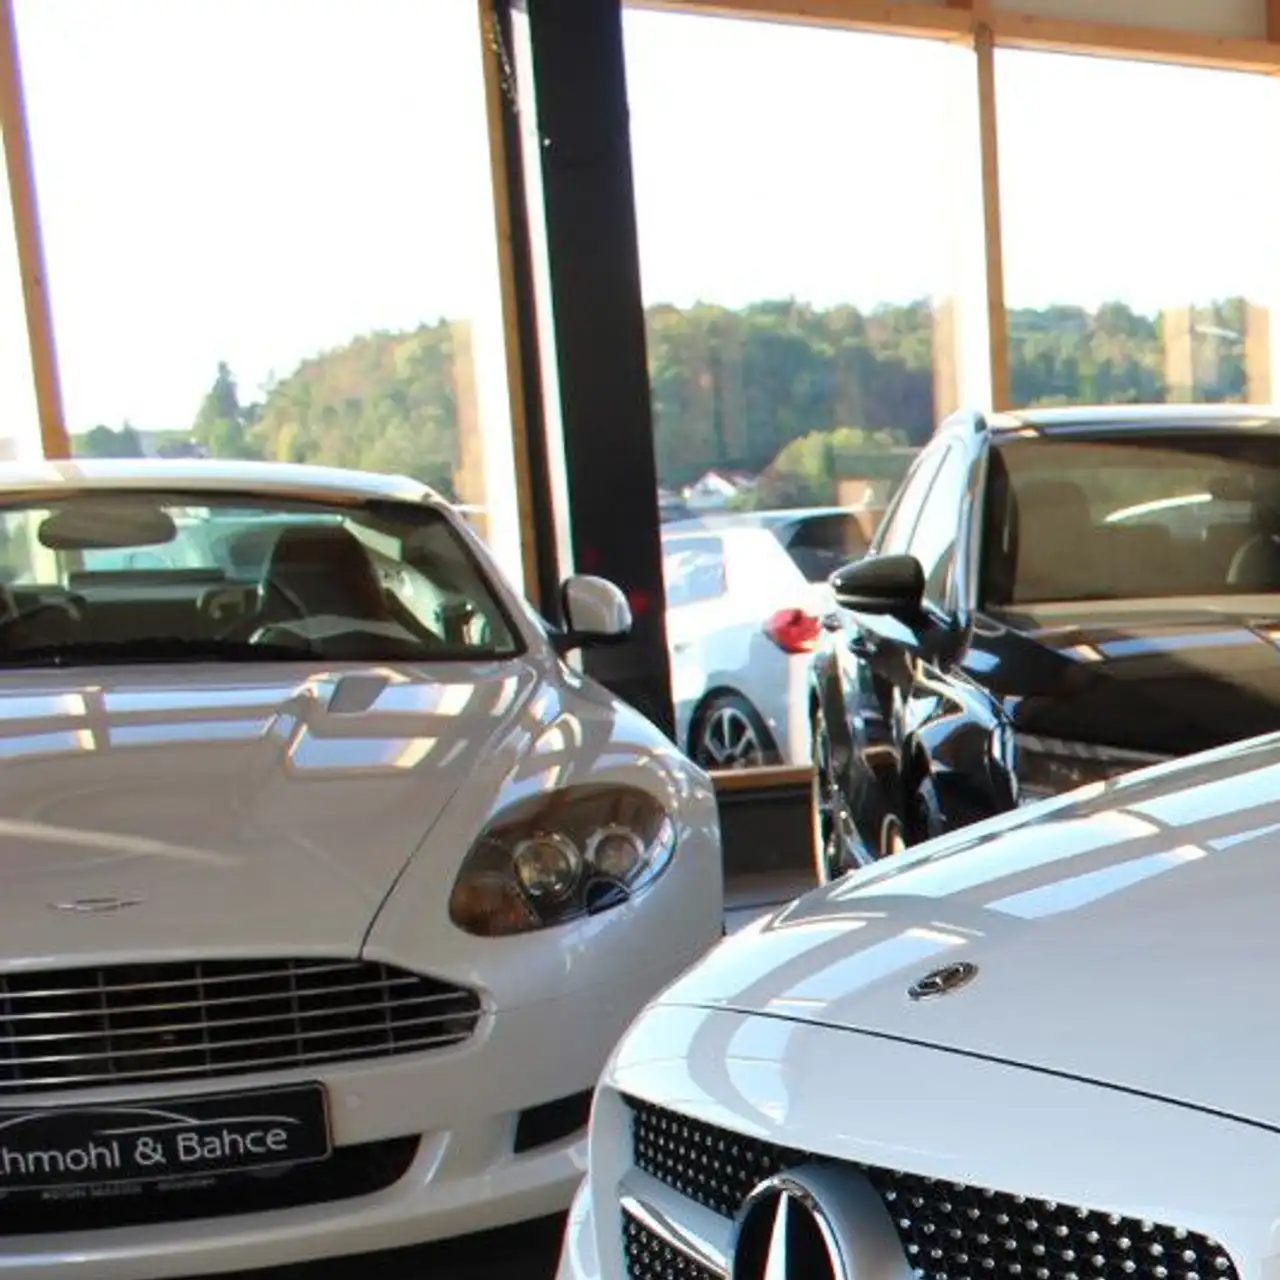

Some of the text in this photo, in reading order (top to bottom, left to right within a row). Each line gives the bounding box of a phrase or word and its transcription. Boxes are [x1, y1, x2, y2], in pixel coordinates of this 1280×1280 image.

[0, 1128, 288, 1175] hmohl & Bahce
